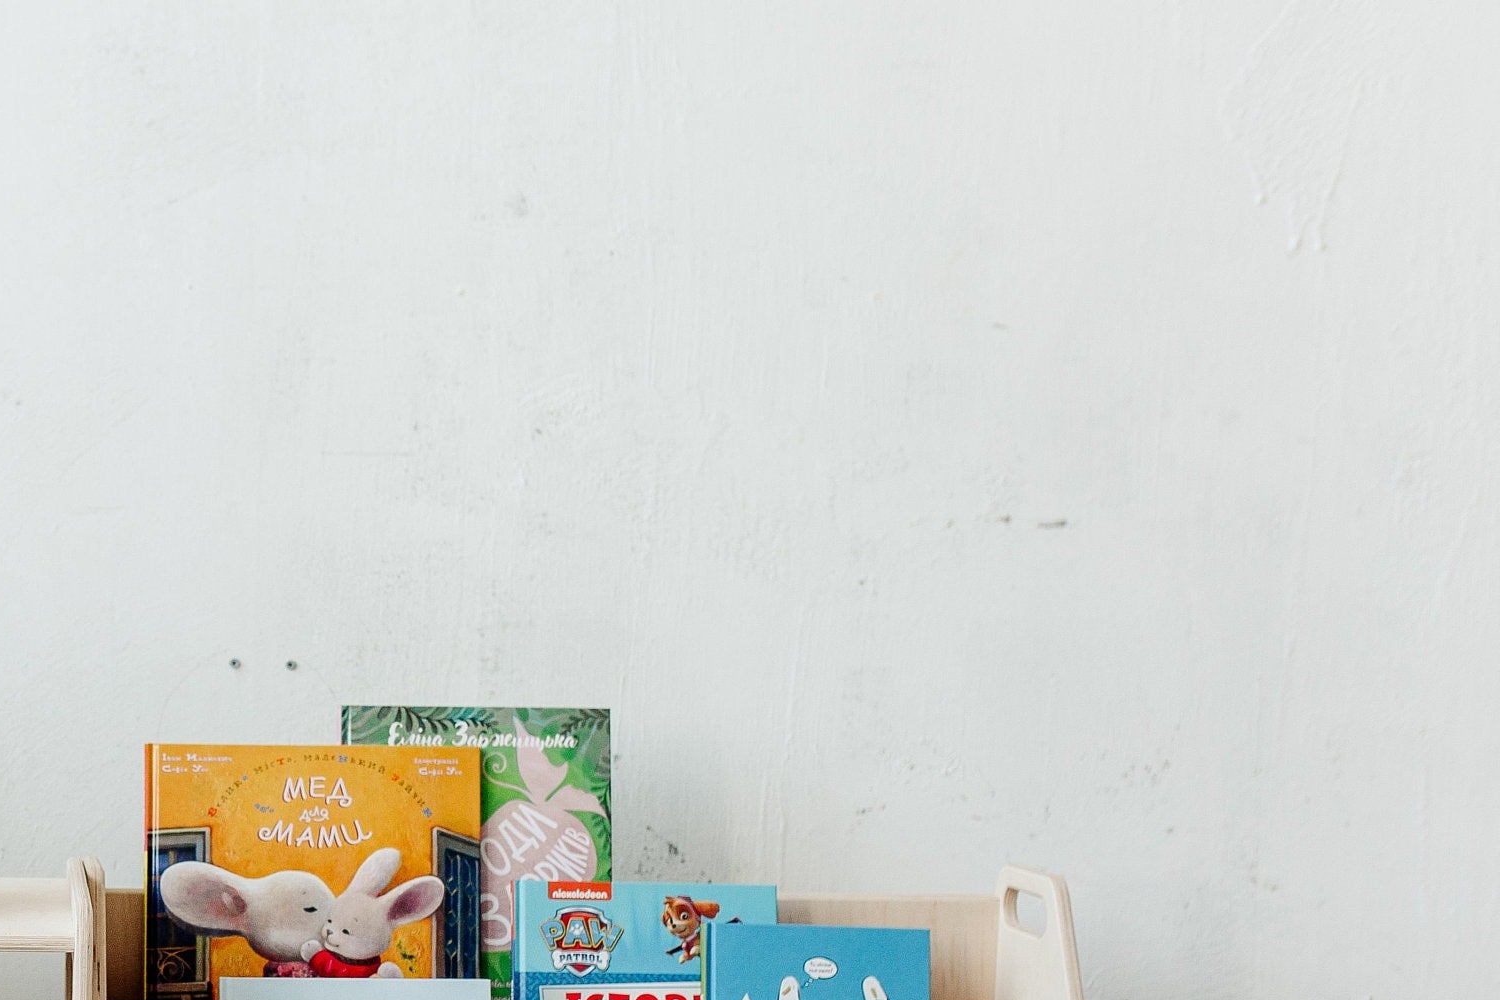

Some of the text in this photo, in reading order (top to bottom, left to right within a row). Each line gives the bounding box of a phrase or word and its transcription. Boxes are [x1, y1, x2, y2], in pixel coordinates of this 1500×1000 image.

[387, 720, 579, 750] Еліна Заржицька
[282, 776, 353, 808] МЕД
[258, 819, 373, 848] МАМИ
[552, 887, 608, 899] nickelodeon
[539, 917, 624, 951] PAW
[559, 953, 602, 964] PATROL
